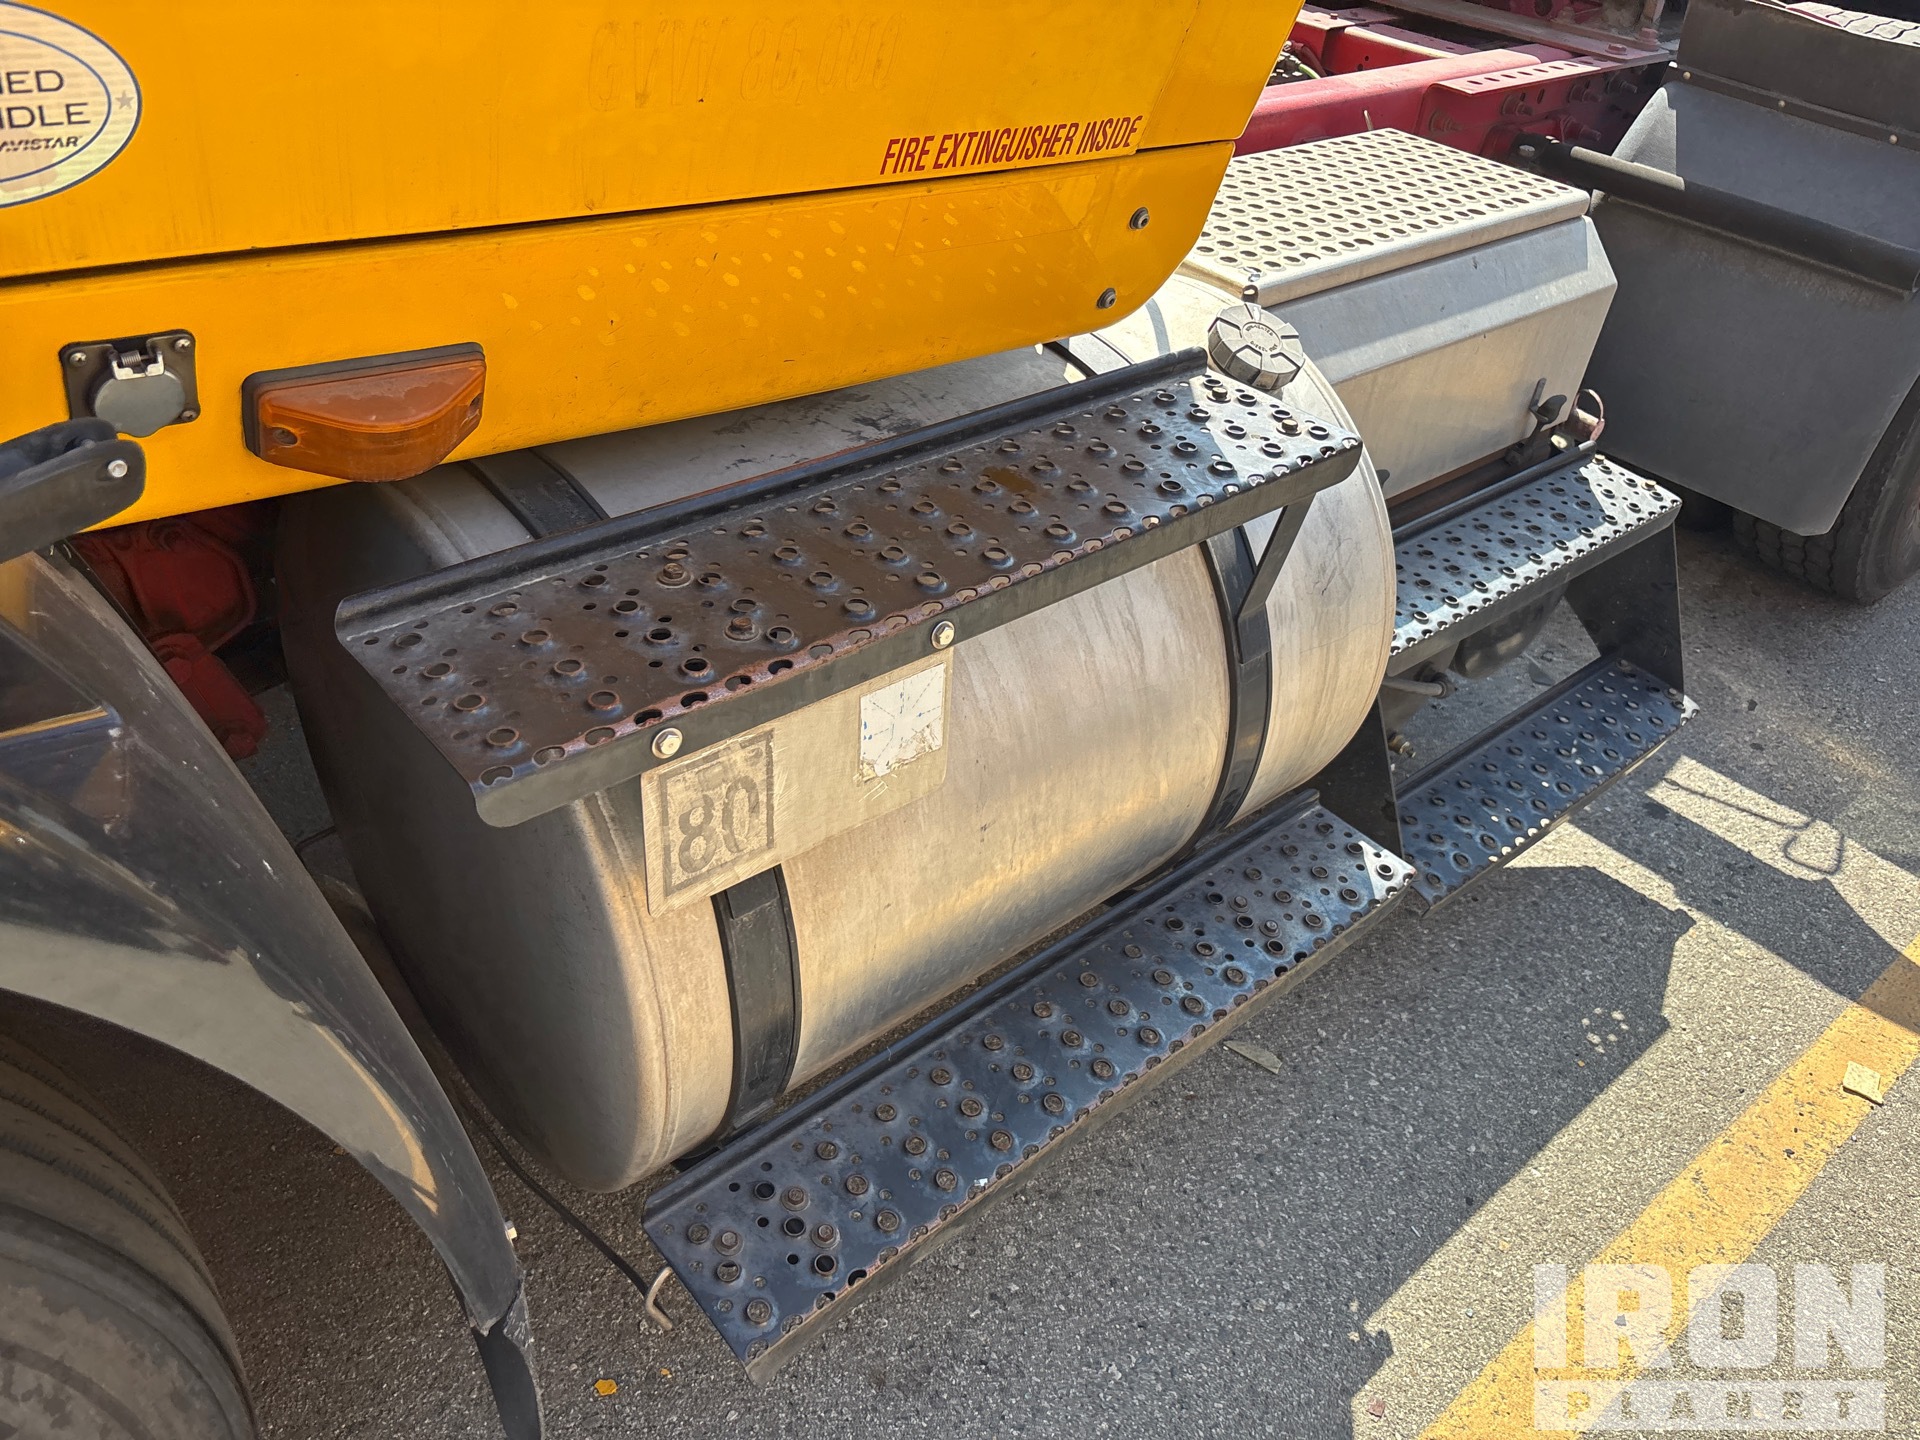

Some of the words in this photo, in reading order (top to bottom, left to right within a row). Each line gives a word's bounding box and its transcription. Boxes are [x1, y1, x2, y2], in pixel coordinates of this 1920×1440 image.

[880, 135, 935, 176] FIRE
[933, 122, 1079, 170] EXTINGUISHER
[1076, 115, 1143, 156] INSIDE
